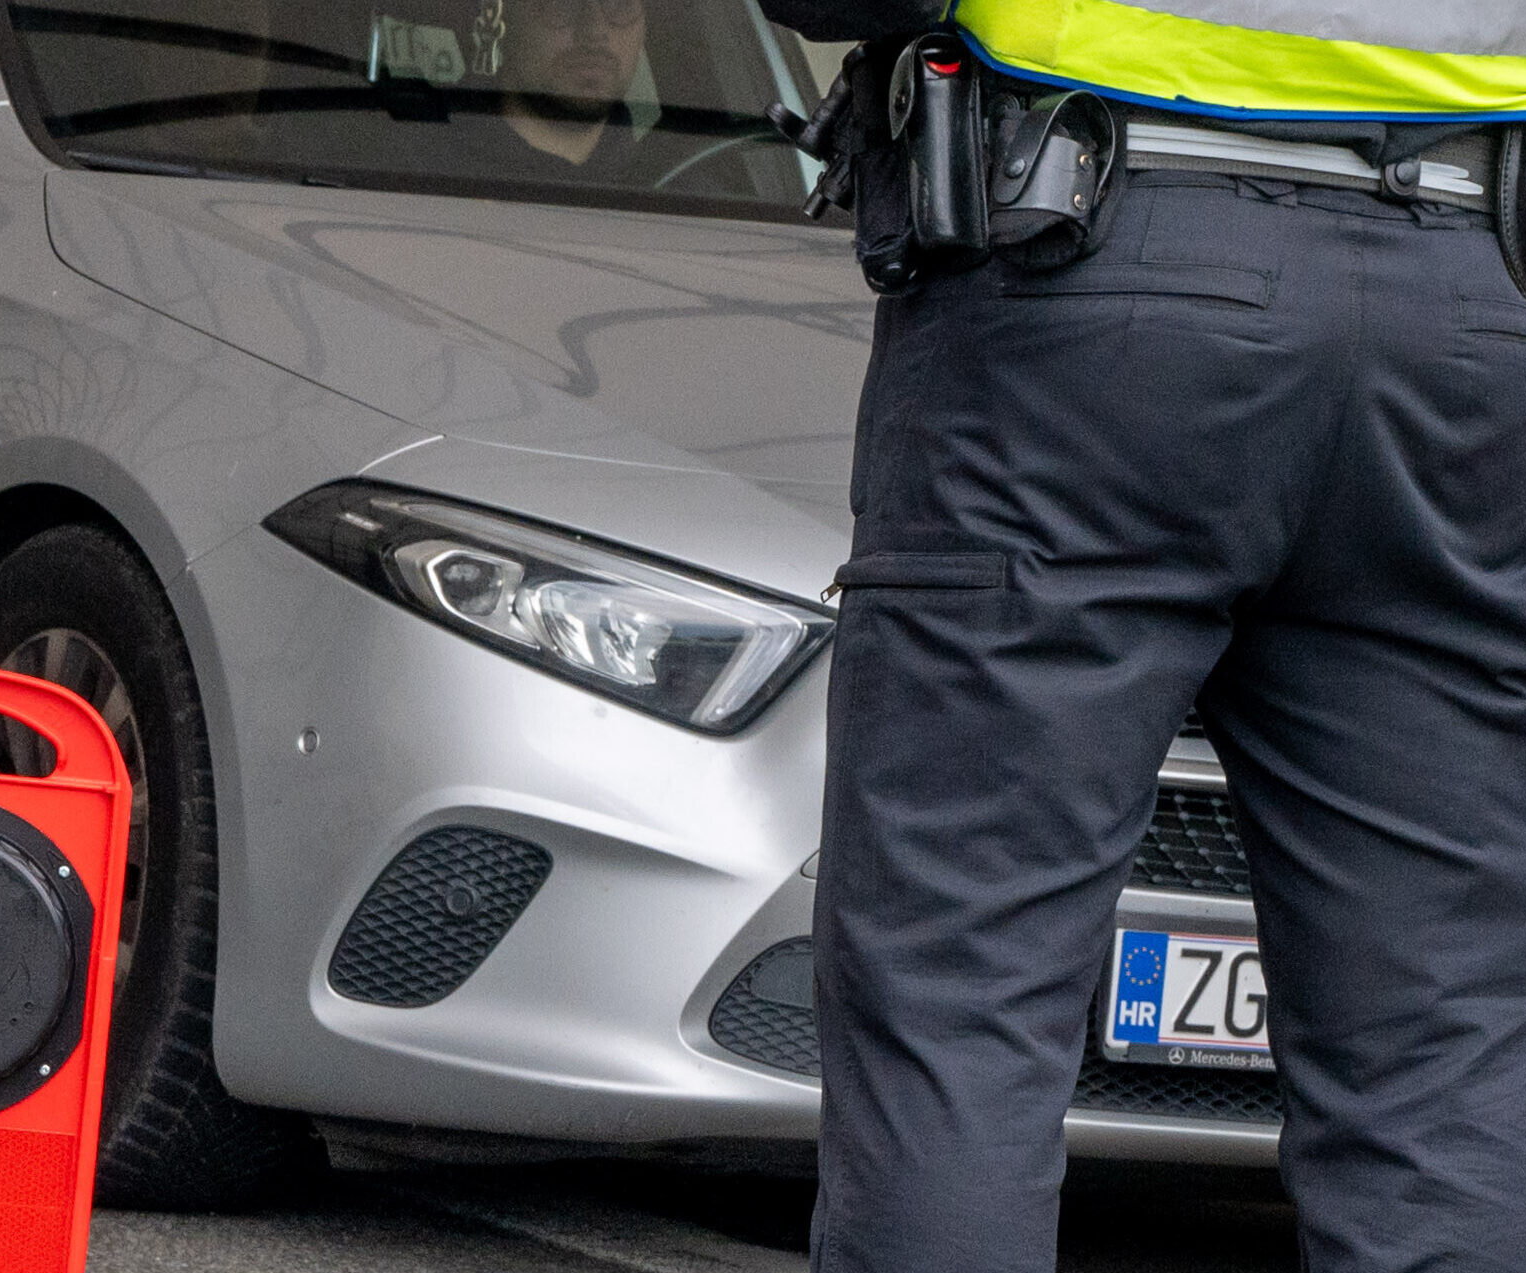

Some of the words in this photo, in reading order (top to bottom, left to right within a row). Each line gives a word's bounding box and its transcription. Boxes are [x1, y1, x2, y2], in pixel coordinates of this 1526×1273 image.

[1172, 947, 1268, 1038] ZG
[1119, 1000, 1157, 1027] HR
[1191, 1050, 1276, 1070] Mercedes-Ben
